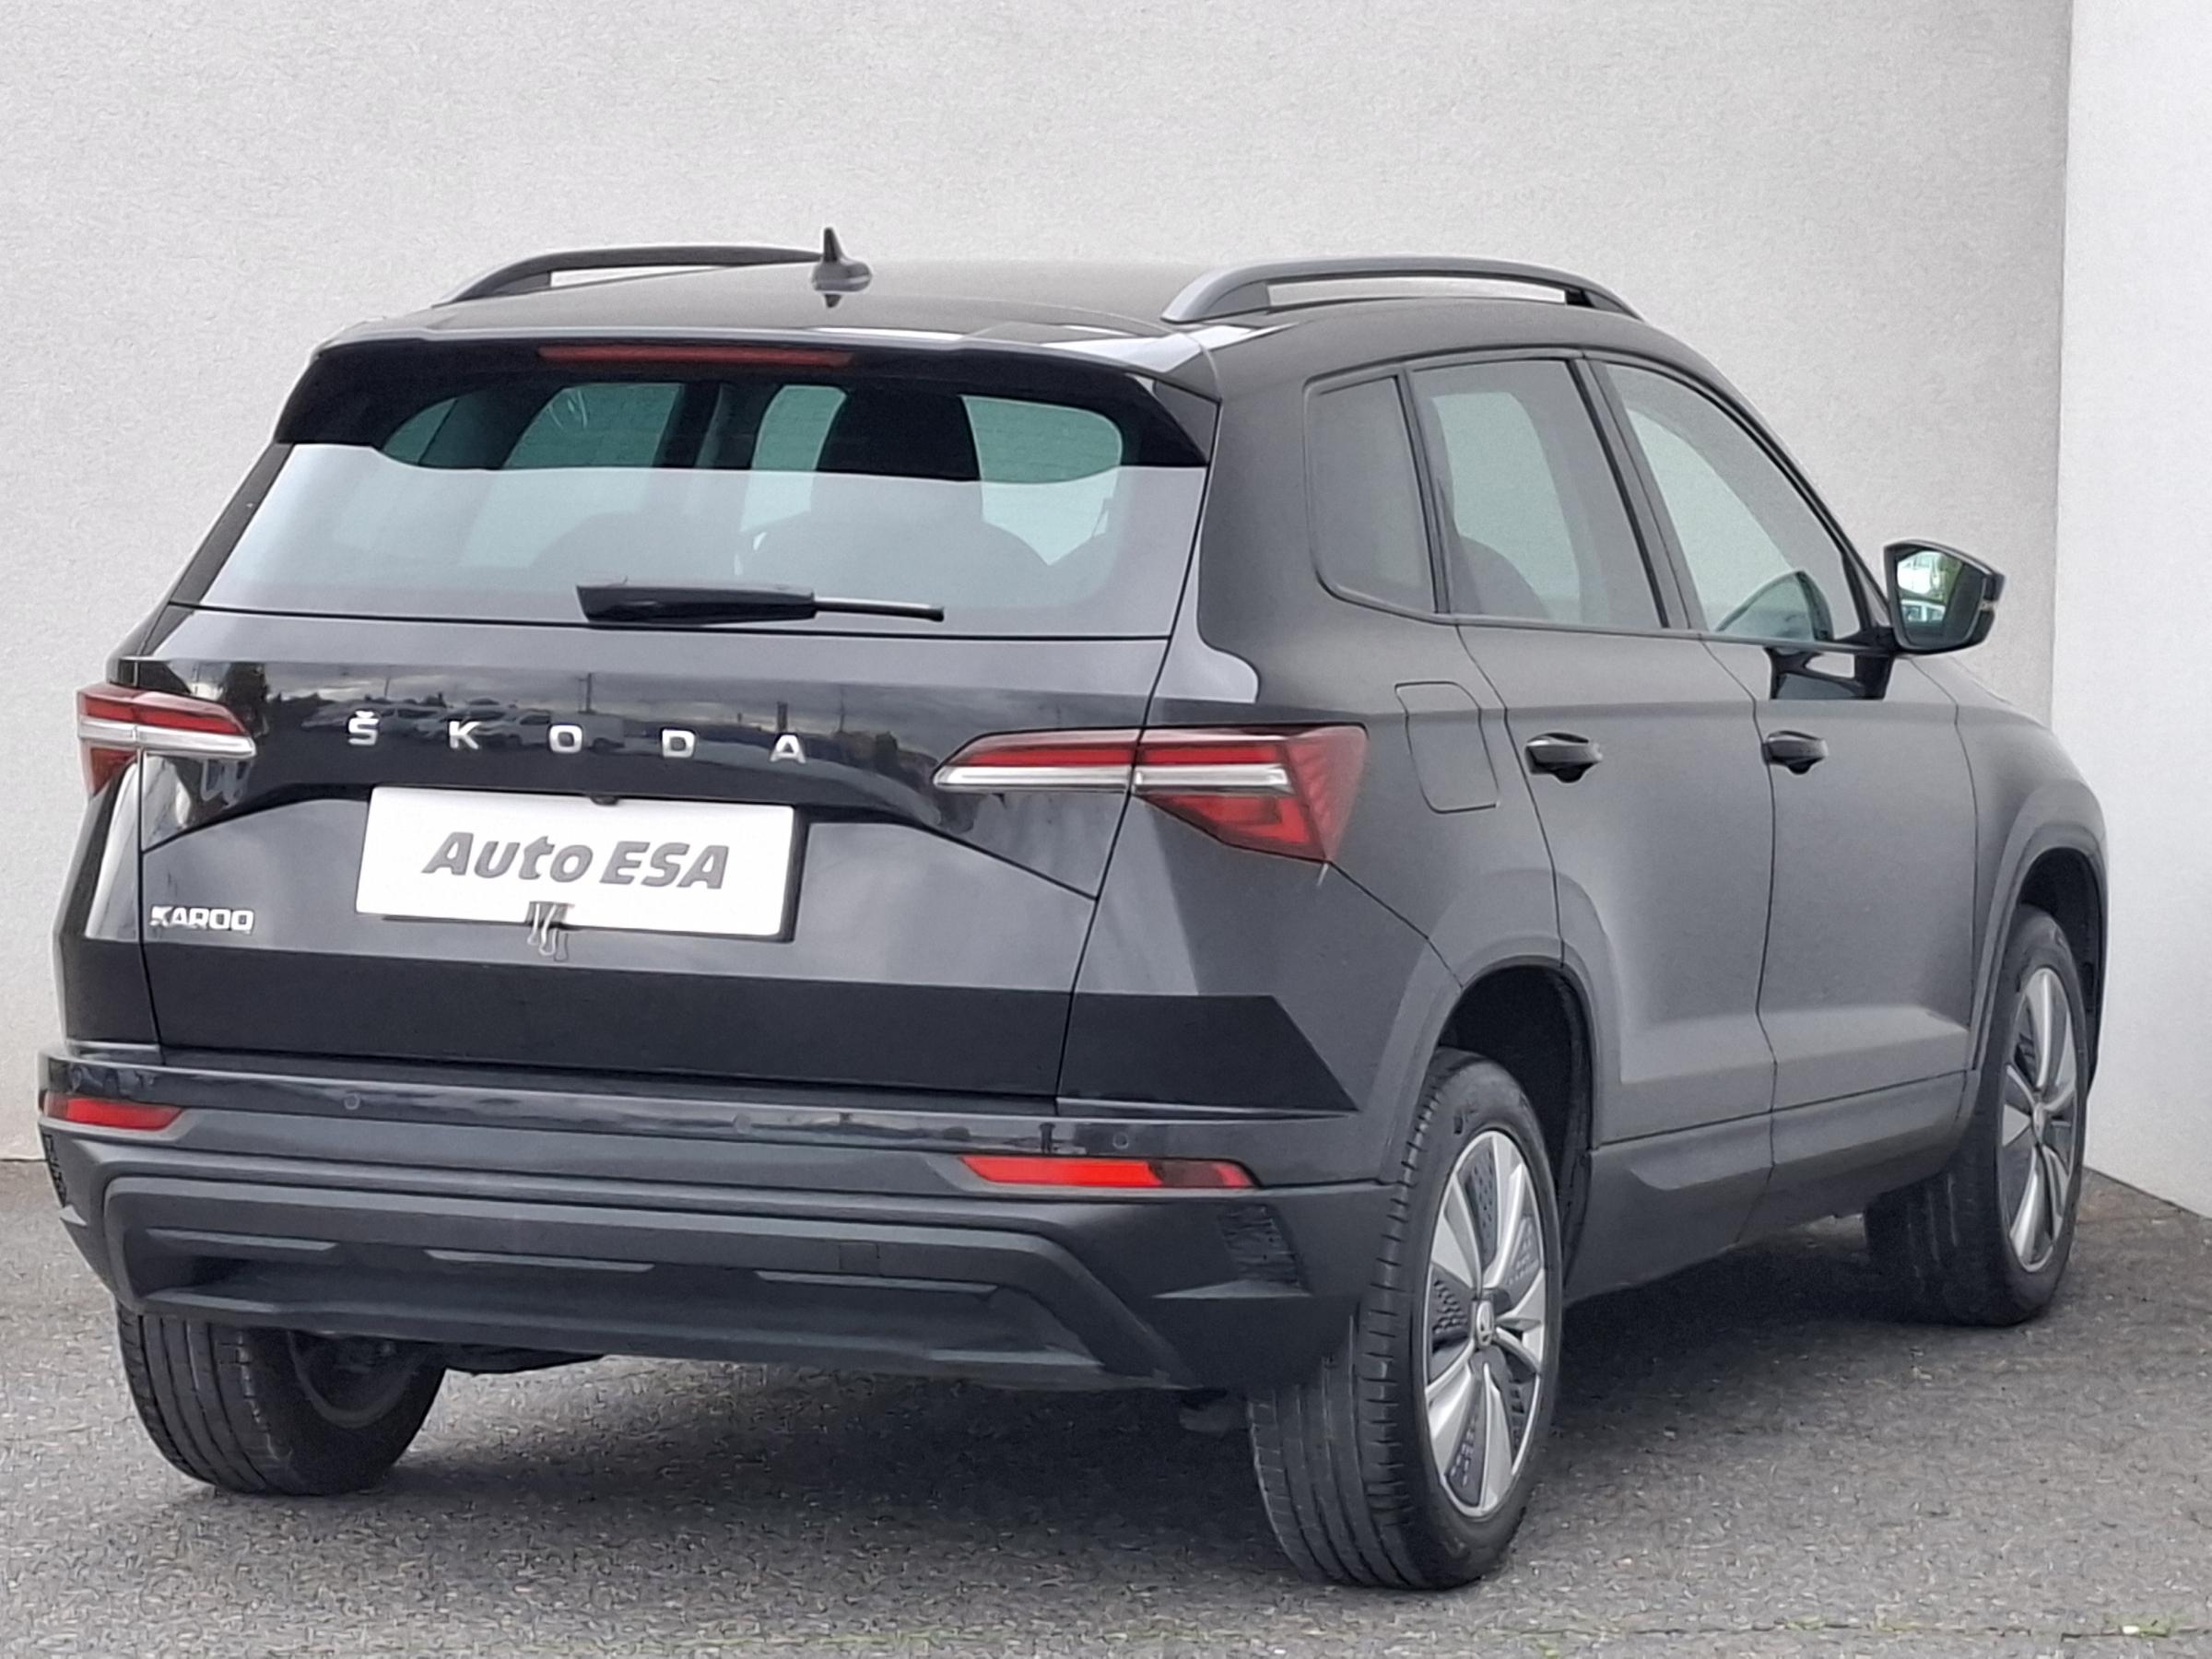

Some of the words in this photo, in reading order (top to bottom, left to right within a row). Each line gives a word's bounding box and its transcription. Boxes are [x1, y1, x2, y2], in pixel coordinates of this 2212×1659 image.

[347, 711, 806, 763] ŠKODA
[421, 831, 594, 882] Auto
[599, 841, 730, 889] ESA
